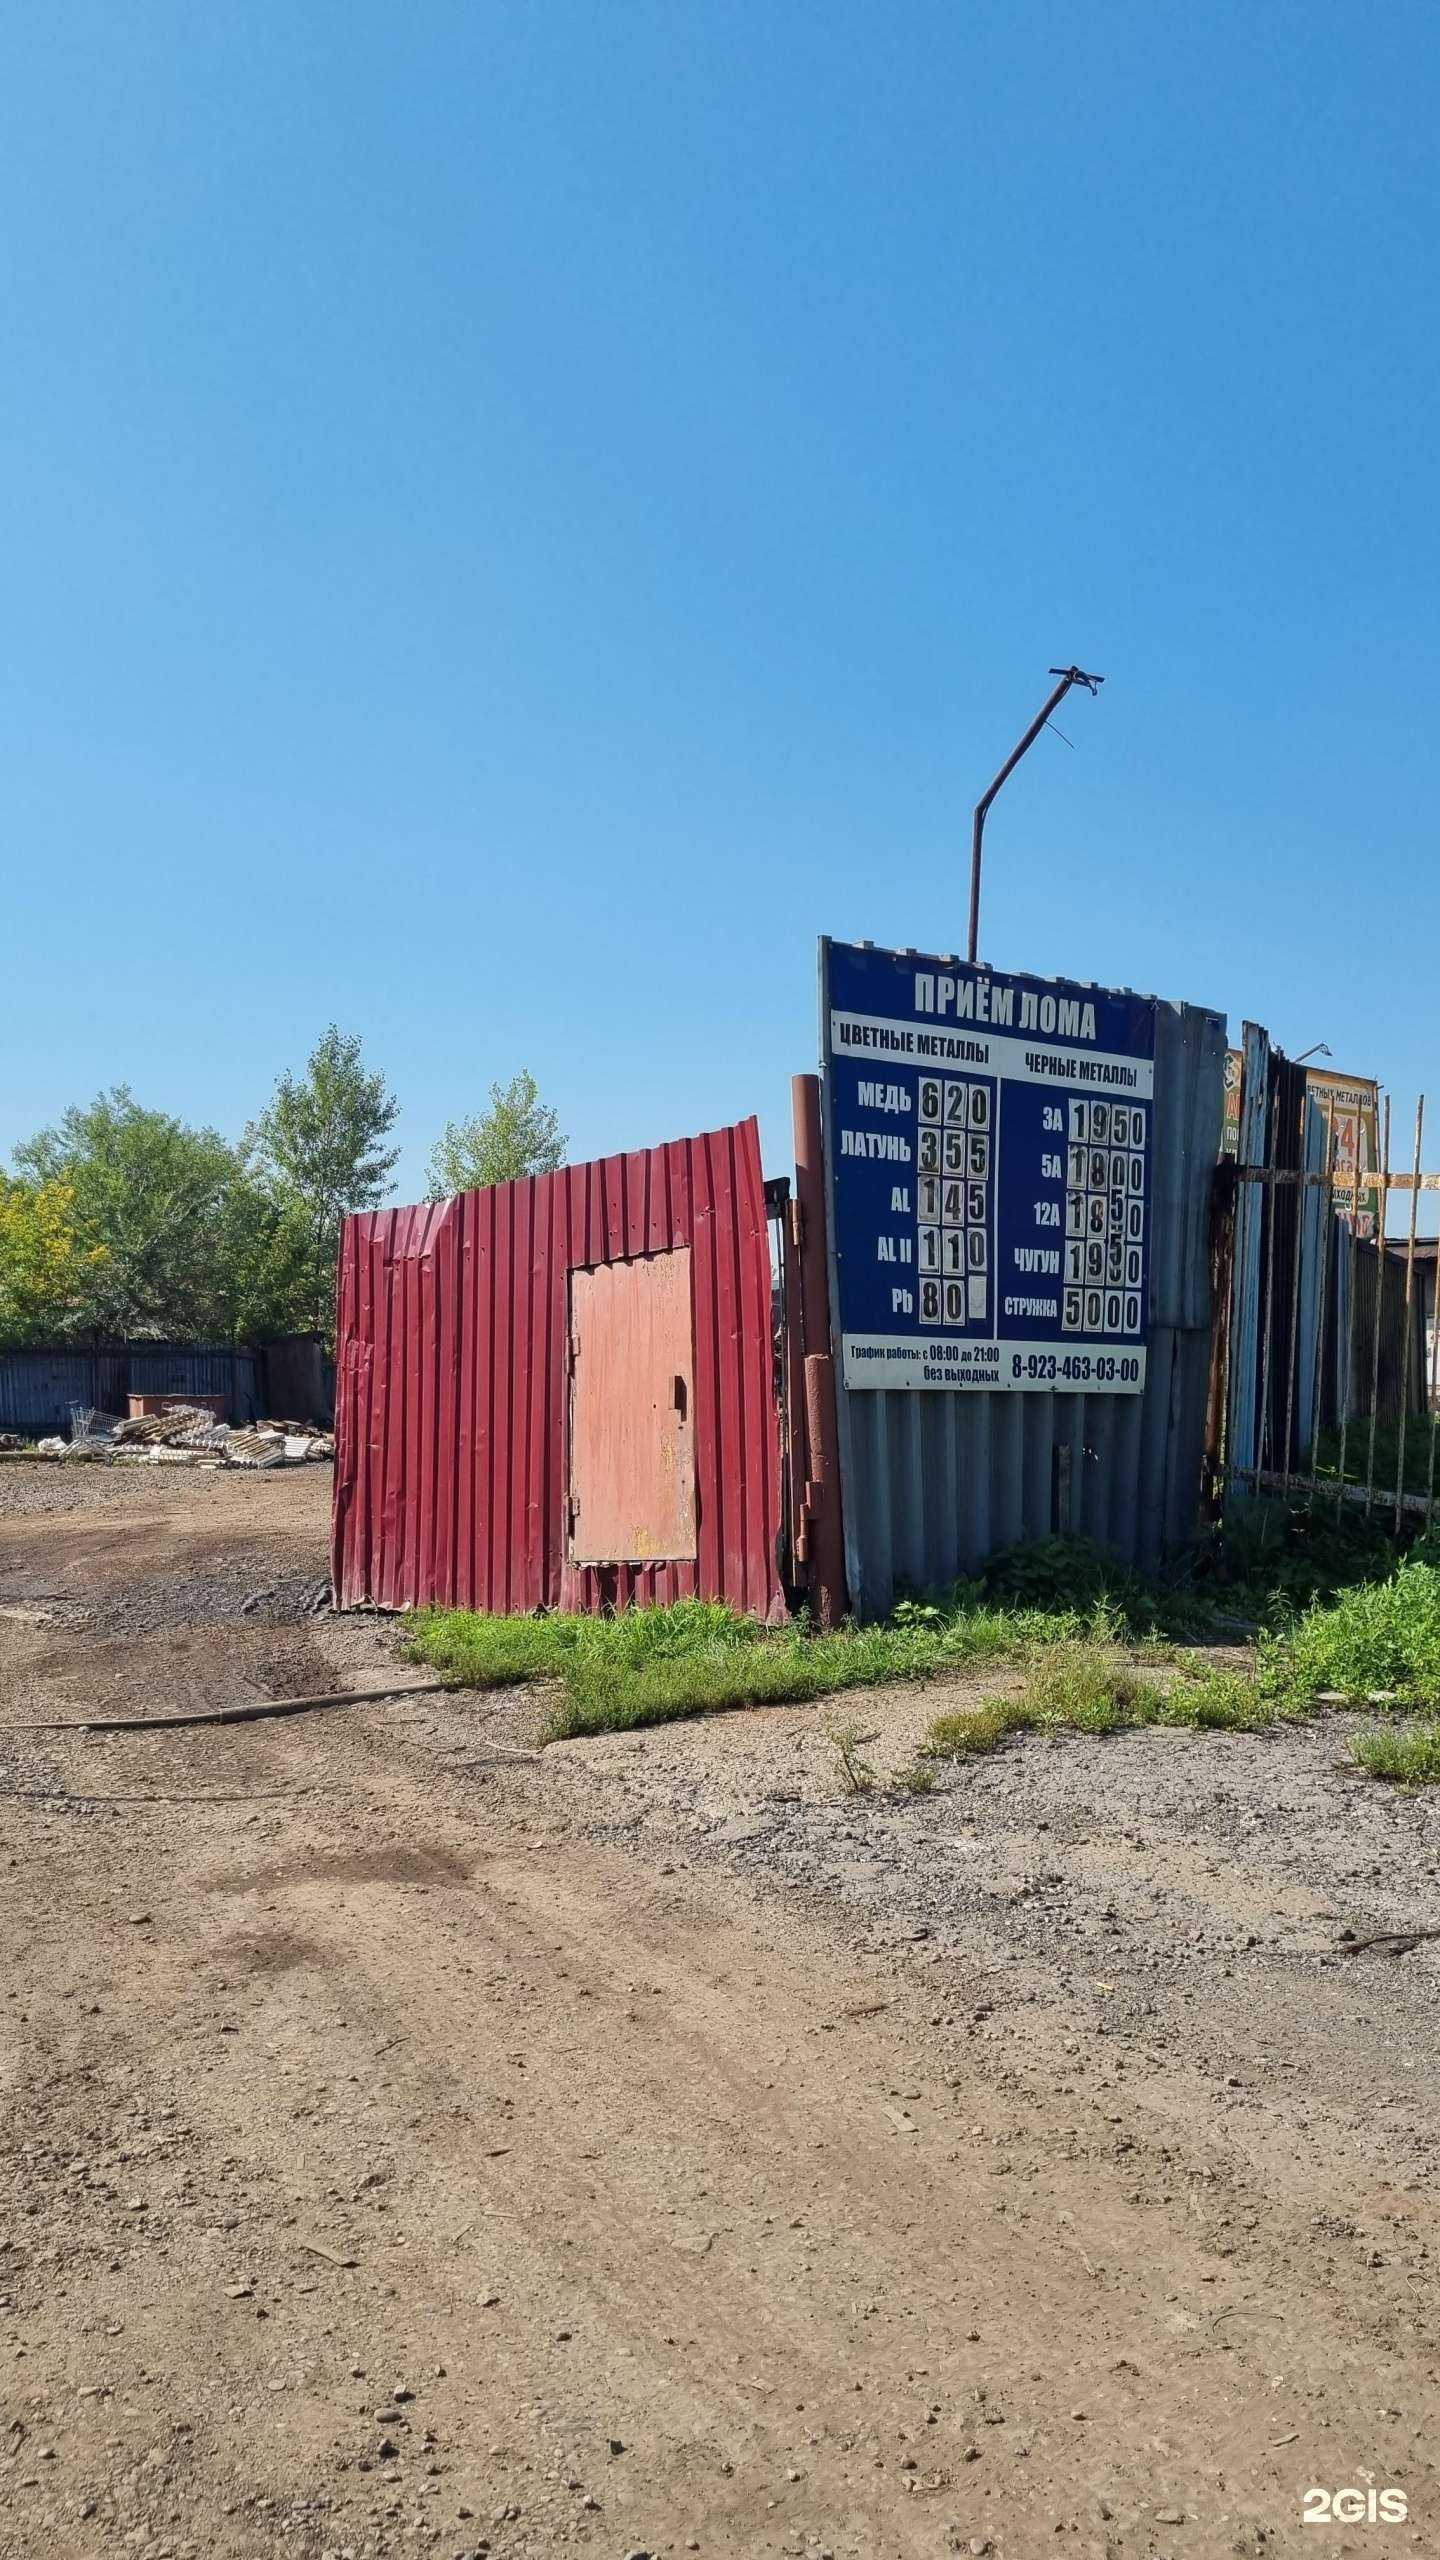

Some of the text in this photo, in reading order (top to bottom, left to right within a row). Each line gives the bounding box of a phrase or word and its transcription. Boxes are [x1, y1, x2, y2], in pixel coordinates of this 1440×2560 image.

[915, 972, 1096, 1040] ПРИЁМ ЛОМА
[840, 1023, 989, 1064] ЦВЕТНЫЕ МЕТАЛЛЫ
[1025, 1052, 1137, 1087] ЧЕРНЫЕ МЕТАЛЛЫ
[857, 1081, 987, 1125] МЕДЬ 620
[1042, 1104, 1143, 1145] 3А 1950
[840, 1129, 986, 1173] ЛАТУНЬ 355
[1041, 1149, 1142, 1191] 5А 1800
[891, 1179, 985, 1220] AL 145
[1033, 1202, 1061, 1226] 12А
[877, 1236, 897, 1262] AL
[923, 1230, 985, 1269] 110
[1014, 1248, 1060, 1274] ЧУГУН
[892, 1282, 962, 1319] Pb 80
[1004, 1292, 1138, 1329] СТРУЖКА 5000
[851, 1345, 999, 1362] График работы: с 08:00 до 21:00
[1012, 1354, 1139, 1382] 8-923-463-03-00
[923, 1365, 1000, 1383] без выходных
